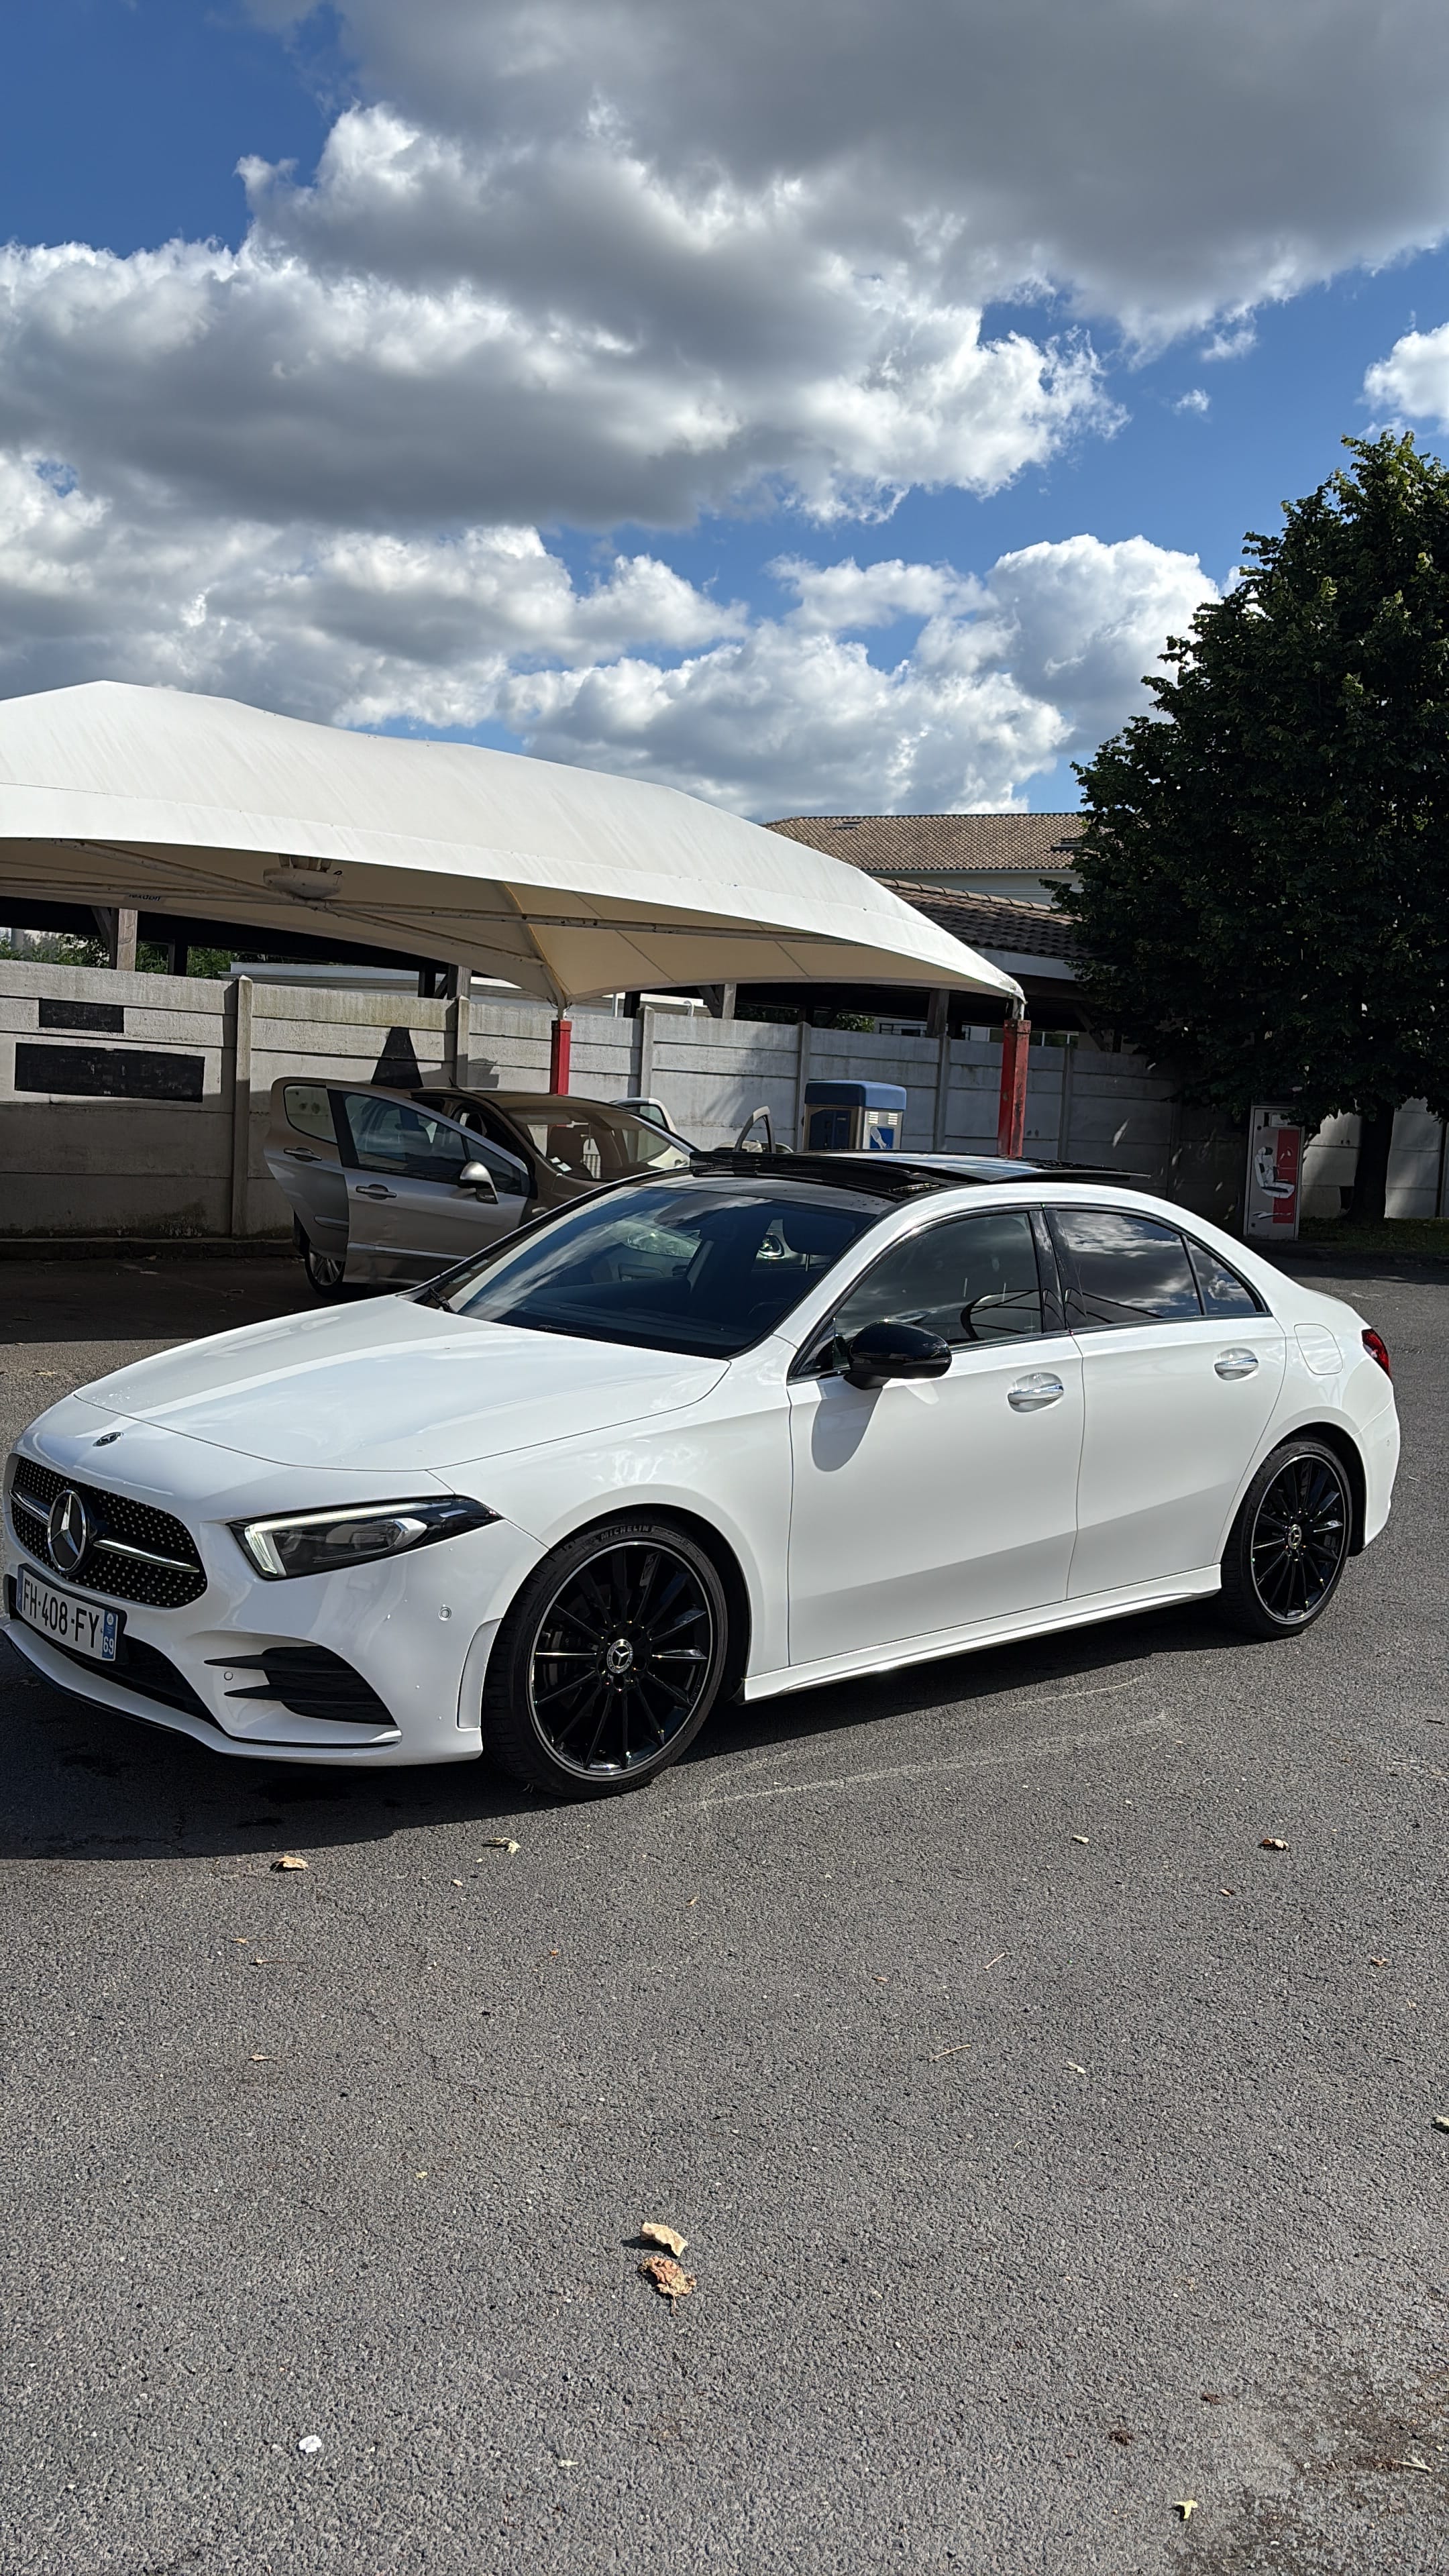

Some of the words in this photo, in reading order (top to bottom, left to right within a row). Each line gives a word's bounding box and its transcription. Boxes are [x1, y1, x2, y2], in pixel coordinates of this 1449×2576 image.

[601, 1525, 649, 1540] MICHELIN
[23, 1578, 100, 1648] FH-408-FY
[103, 1635, 114, 1656] 69
